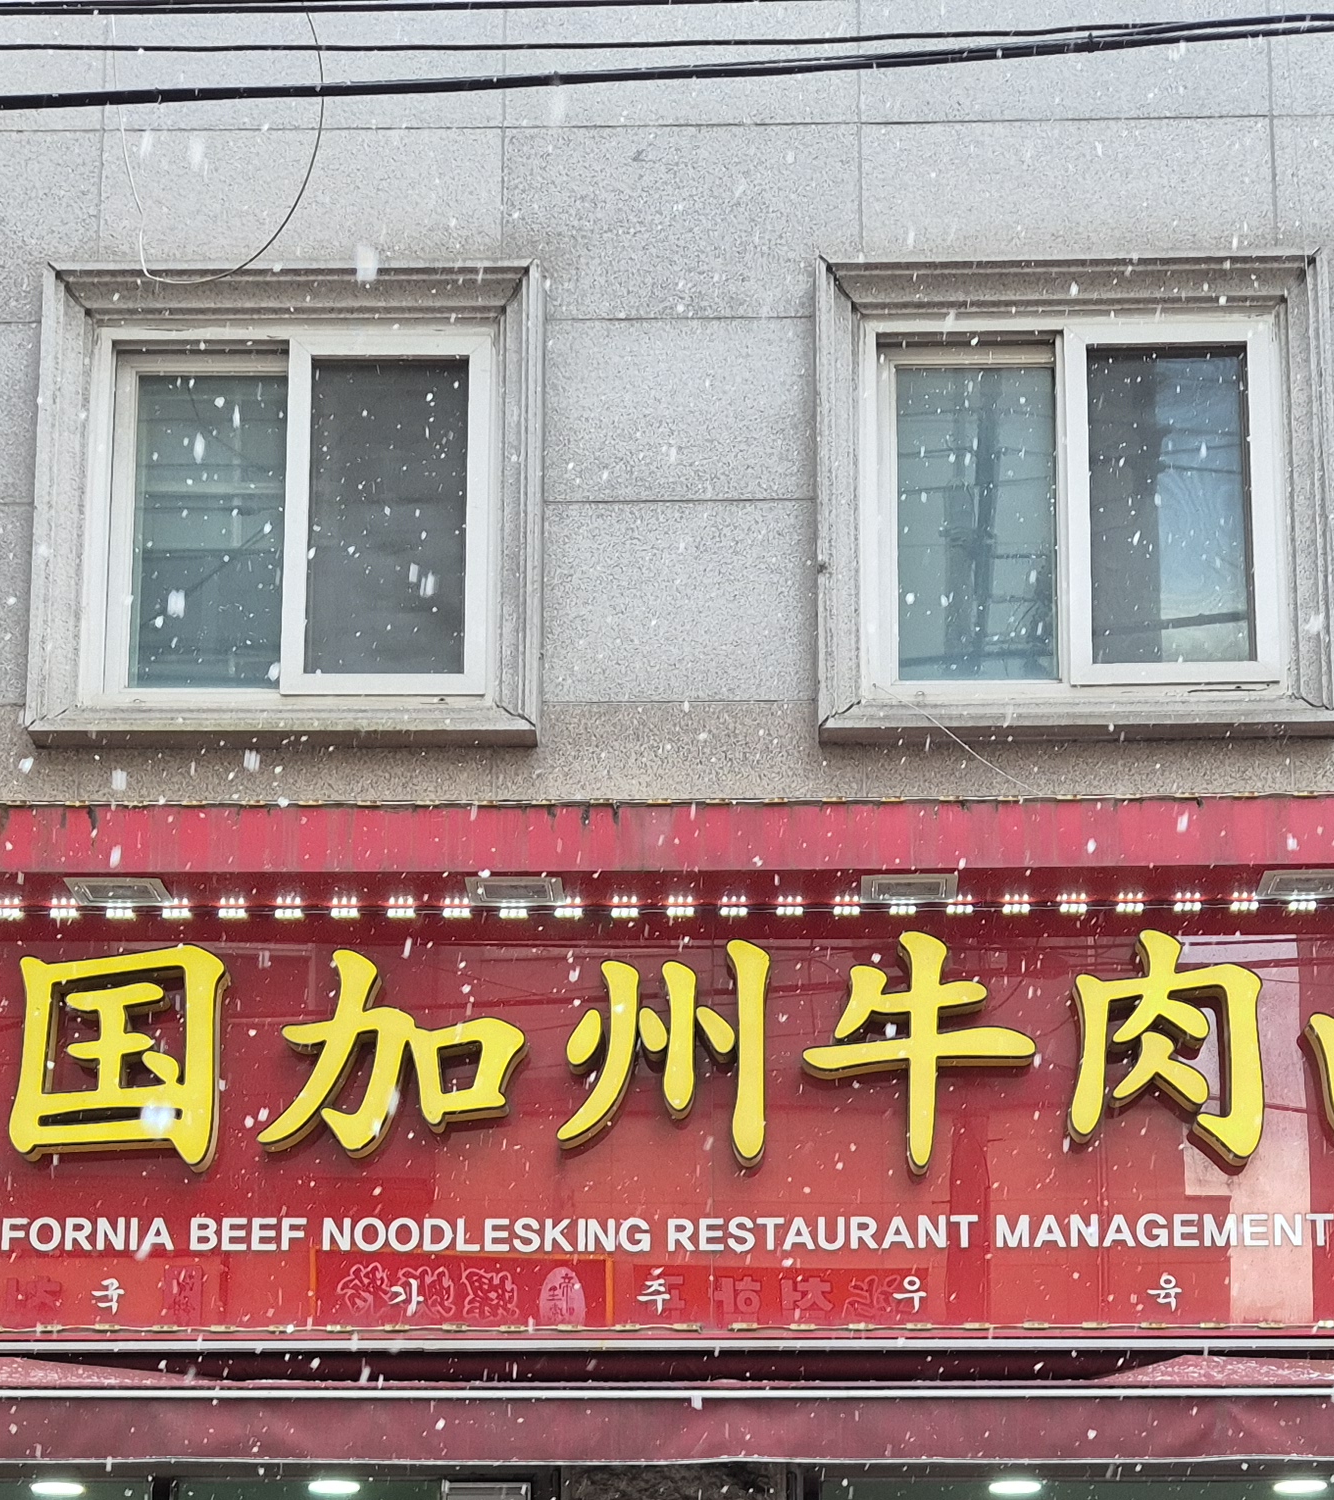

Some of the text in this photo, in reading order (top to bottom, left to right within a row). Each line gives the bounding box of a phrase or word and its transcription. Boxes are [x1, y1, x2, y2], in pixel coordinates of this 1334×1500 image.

[189, 1215, 307, 1252] BEEF
[321, 1214, 651, 1251] NOODLESKING
[667, 1213, 979, 1250] RESTAURANT
[994, 1213, 1334, 1250] MANAGEMENT
